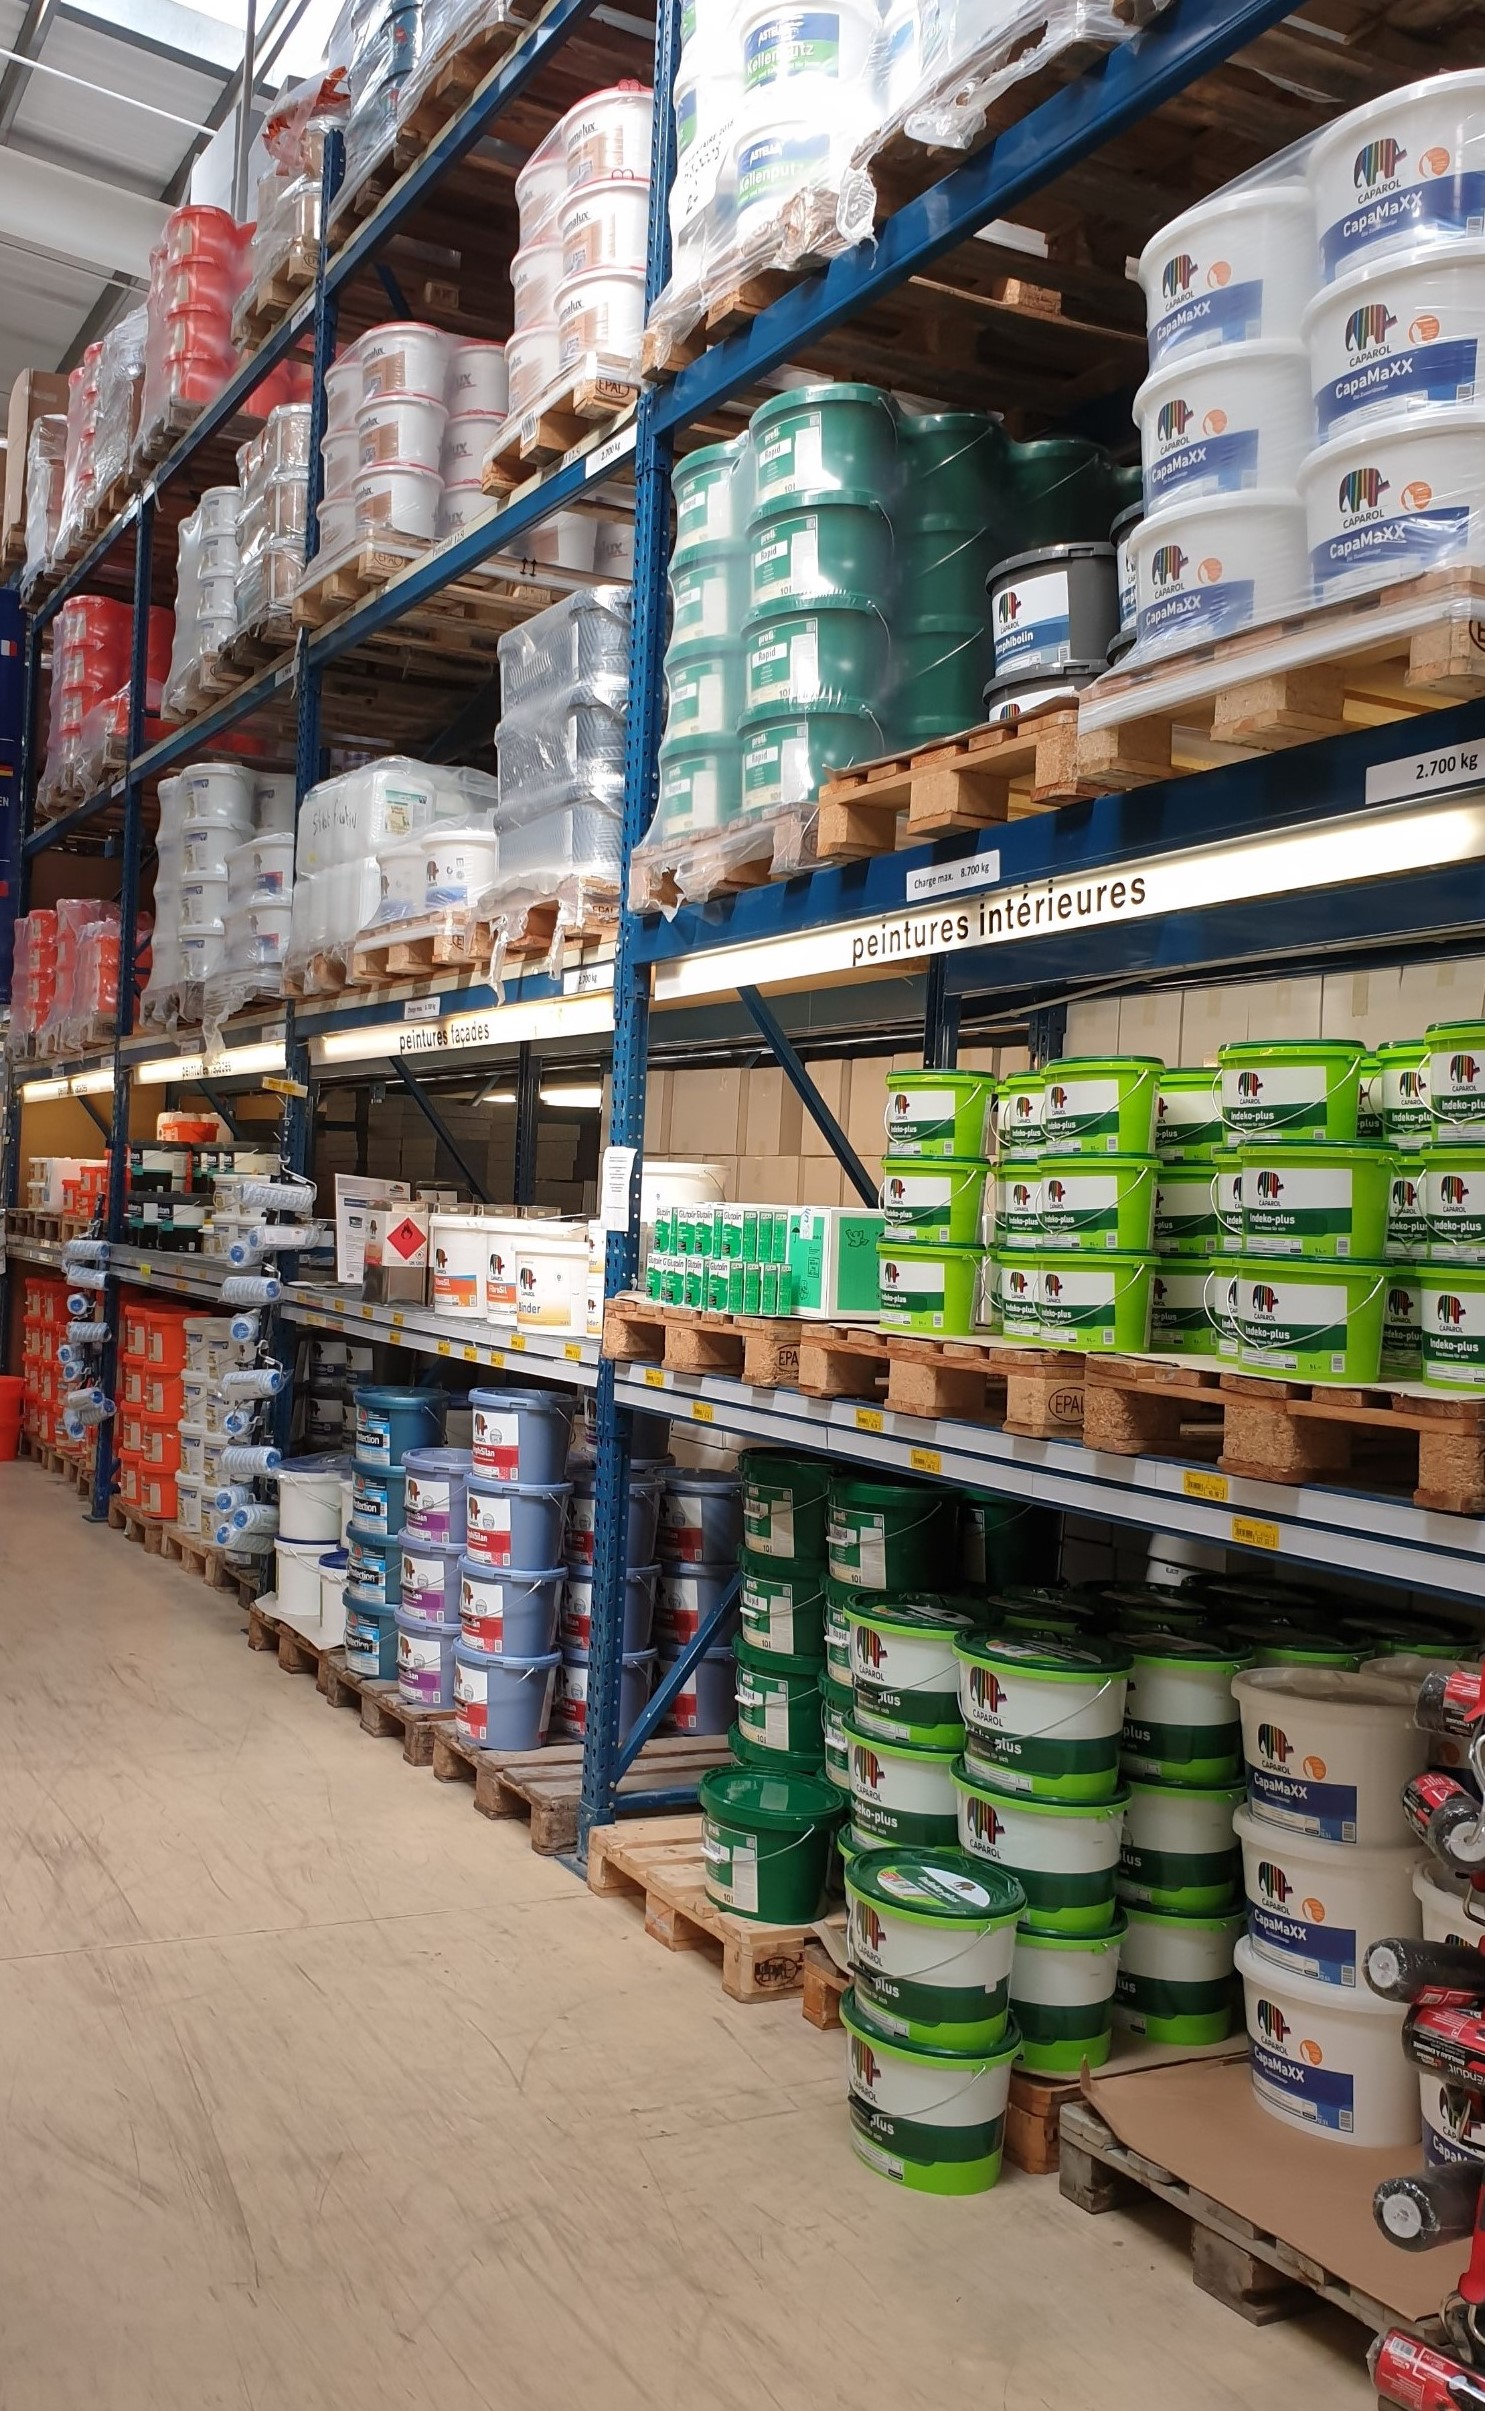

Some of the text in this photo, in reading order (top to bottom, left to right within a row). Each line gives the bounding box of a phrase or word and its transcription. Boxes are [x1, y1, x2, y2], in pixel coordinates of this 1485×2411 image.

[747, 43, 814, 76] Kellenutz
[1357, 178, 1402, 204] CAPAROL
[1342, 190, 1423, 238] CapaMaXX
[1165, 290, 1195, 312] CAPAROL
[1156, 300, 1211, 340] CapaMaXX
[1349, 345, 1392, 367] CAPAROL
[1335, 358, 1413, 398] CapaMaXX
[764, 444, 781, 461] Rapid
[1160, 436, 1191, 455] CAPAROL
[1151, 447, 1207, 483] CapaMaXX
[1343, 510, 1385, 529] CAPAROL
[1329, 524, 1407, 559] CapaMaXX
[760, 547, 777, 561] Rapid
[1154, 582, 1185, 600] CAPAROL
[1145, 595, 1202, 627] CapaMaXX
[758, 648, 776, 662] Rapid
[751, 751, 768, 763] Rapid
[1416, 752, 1478, 780] 2.700 kg
[913, 862, 990, 890] Charge max. 8.700 kg
[851, 875, 1147, 967] peintures intérieures
[399, 1020, 490, 1055] peintures façades
[1231, 1111, 1275, 1121] Indeko-plus
[1392, 1111, 1433, 1123] Indeko-plu
[724, 1211, 742, 1221] Glutolin
[1044, 1215, 1075, 1225] Indeko-plus
[1249, 1212, 1295, 1225] Indeko-plus
[1433, 1220, 1481, 1232] Indeko-plus
[710, 1260, 728, 1271] Glutolin
[518, 1301, 541, 1314] Binder
[1254, 1313, 1276, 1321] CAPAROL
[1246, 1325, 1290, 1340] Indeko-plus
[1384, 1330, 1420, 1341] deko-plu
[1430, 1338, 1479, 1352] Indeko-plus
[778, 1350, 799, 1366] EPA
[859, 1665, 884, 1681] CAPAROL
[972, 1709, 1004, 1727] CAPAROL
[1262, 1760, 1291, 1775] CAPAROL
[856, 1784, 882, 1802] CAPAROL
[1254, 1772, 1308, 1800] CapaMaXX
[969, 1839, 1001, 1859] CAPAROL
[1262, 1898, 1290, 1915] CAPAROL
[1254, 1909, 1307, 1941] CapaMaXX
[858, 1943, 882, 1967] CAPAROL
[1261, 2036, 1288, 2056] CAPAROL
[1254, 2045, 1305, 2083] CapaMaXX
[853, 2078, 878, 2103] CAPAROL
[1433, 2134, 1469, 2162] CapaM
